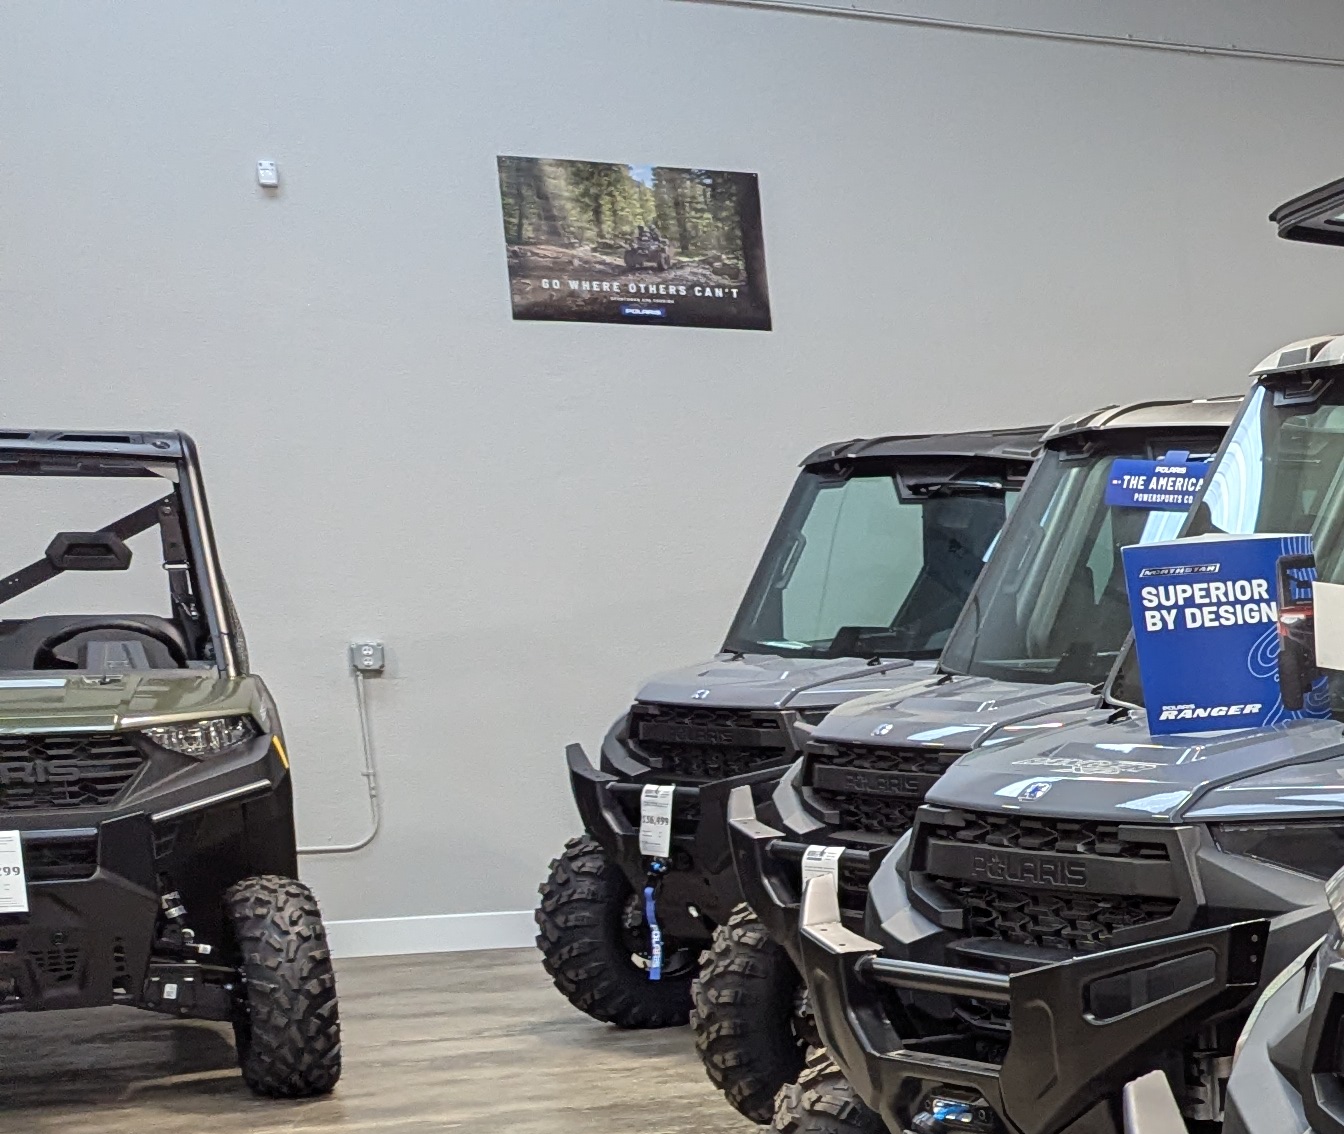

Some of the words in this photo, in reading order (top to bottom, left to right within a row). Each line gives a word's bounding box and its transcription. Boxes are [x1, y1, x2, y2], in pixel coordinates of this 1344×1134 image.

[541, 278, 561, 289] GO
[568, 280, 621, 293] WHERE
[628, 283, 687, 296] OTHERS
[694, 286, 739, 299] CAN'T
[1154, 466, 1187, 474] POLARIS
[1122, 475, 1147, 490] THE
[1148, 476, 1204, 492] AMERICA
[1133, 492, 1182, 504] POWERSPORTS
[1141, 578, 1270, 608] SUPERIOR
[1144, 608, 1178, 632] BY
[1184, 601, 1278, 629] DESIGN
[1159, 703, 1263, 721] RANGER
[971, 853, 1088, 888] POLARIS
